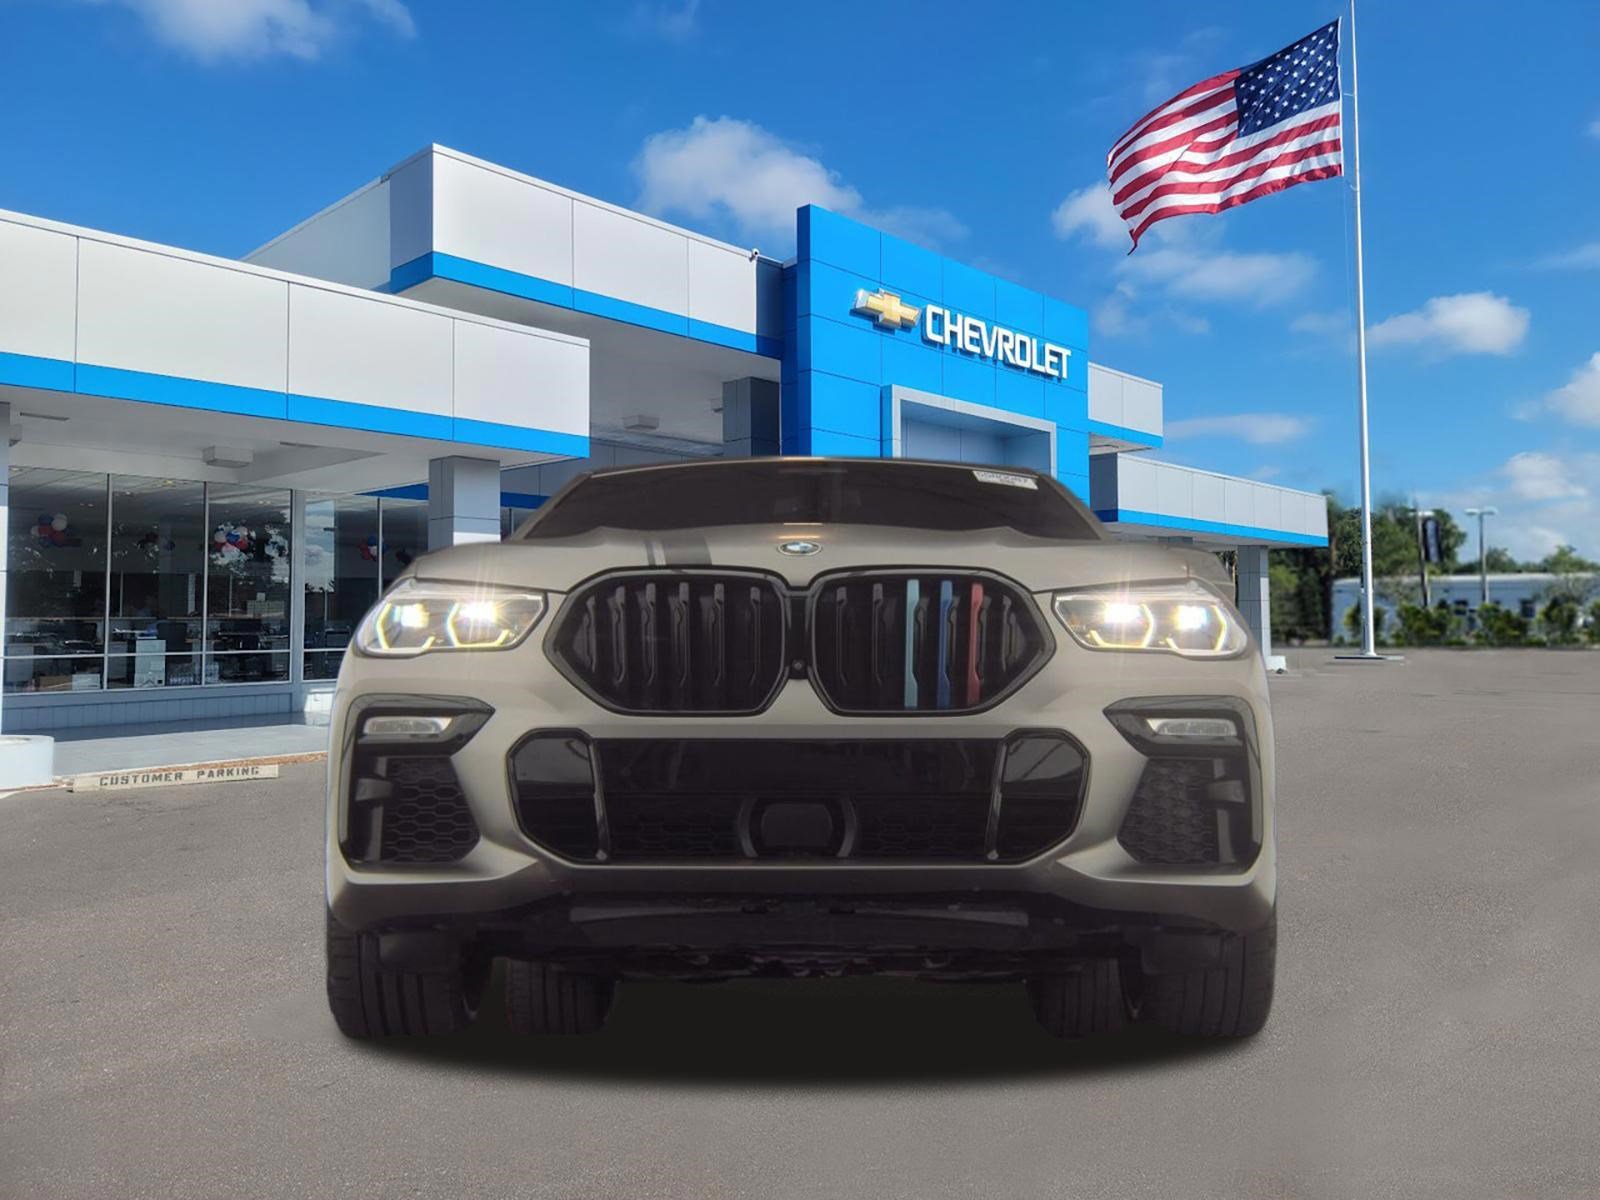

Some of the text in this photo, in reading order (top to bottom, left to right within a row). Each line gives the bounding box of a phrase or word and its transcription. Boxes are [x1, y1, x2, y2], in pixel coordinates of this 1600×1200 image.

[925, 304, 1071, 379] CHEVROLET
[100, 766, 259, 786] CUSTOMER PARKING
